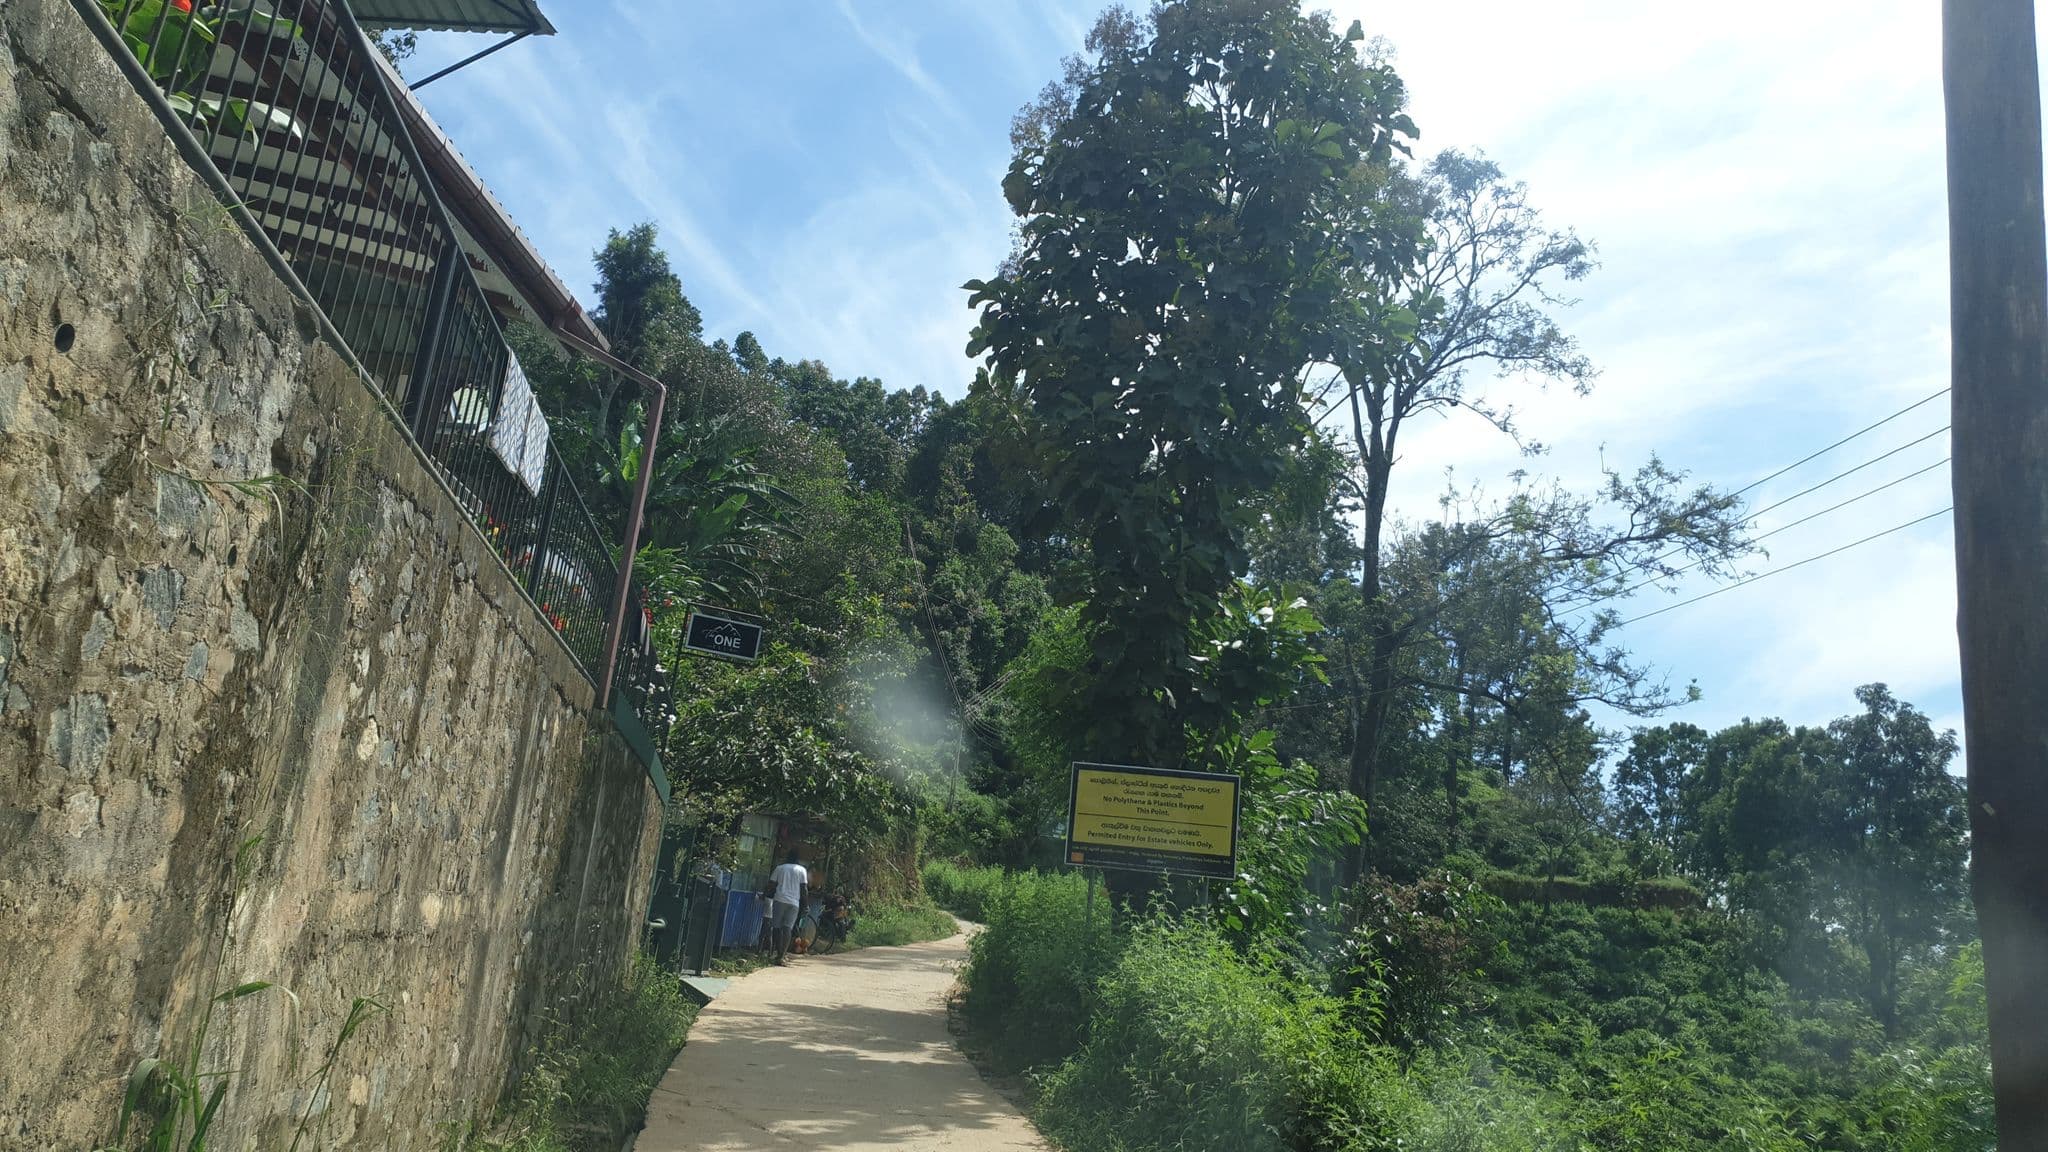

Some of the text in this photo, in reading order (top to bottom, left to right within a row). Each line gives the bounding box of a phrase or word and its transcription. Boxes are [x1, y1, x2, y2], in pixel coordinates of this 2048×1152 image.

[714, 634, 742, 649] ONE
[1137, 807, 1170, 816] This Point.
[1154, 800, 1178, 808] Plastics
[1179, 802, 1203, 811] Beyond
[1118, 833, 1136, 842] Entry
[1148, 836, 1167, 844] Estate
[1168, 838, 1195, 847] vehicles
[1196, 841, 1213, 849] Only.
